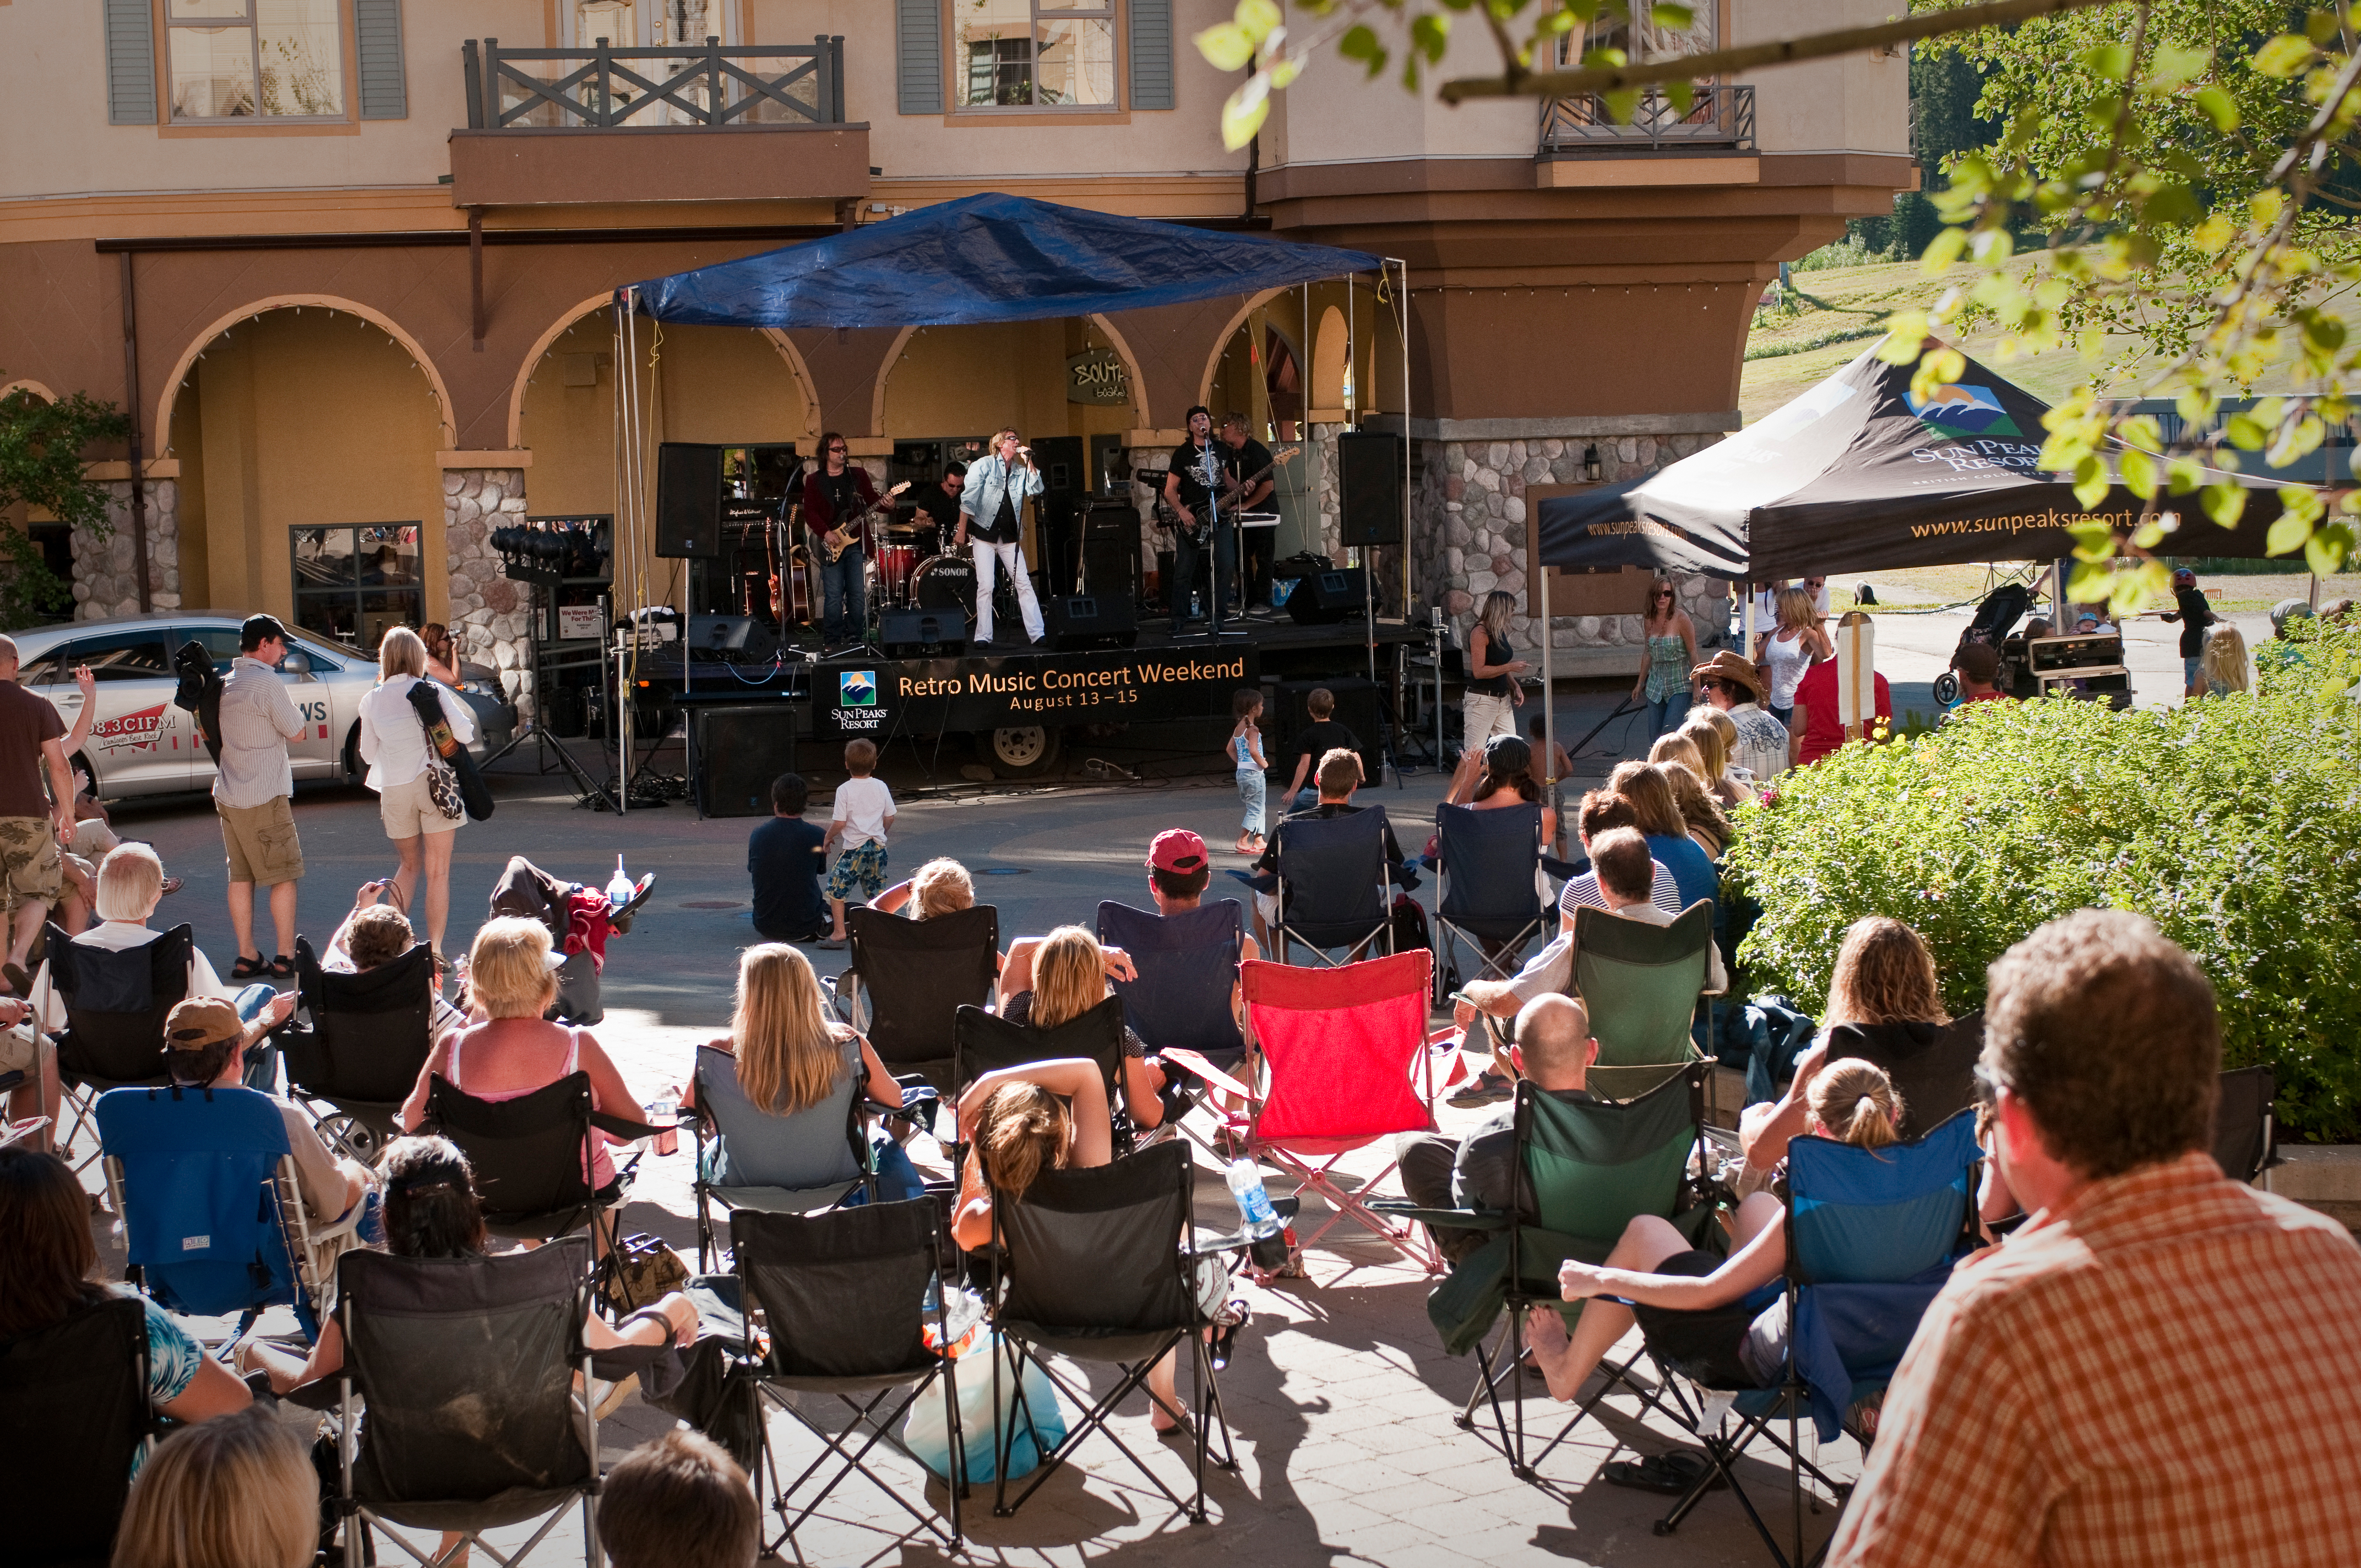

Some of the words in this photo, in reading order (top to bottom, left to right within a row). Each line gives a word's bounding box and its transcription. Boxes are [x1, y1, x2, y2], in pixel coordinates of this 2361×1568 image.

[1911, 444, 1979, 464] SUN
[1974, 439, 2048, 455] PEAK
[1912, 476, 1968, 485] BRITISH
[1973, 471, 2046, 480] COLUMBIA
[1587, 515, 1688, 540] www.sunpeaksresort.com
[1911, 508, 2181, 538] www.sunpeaksresort.co
[938, 568, 969, 576] SONOR
[899, 677, 962, 696] Retro
[969, 671, 1036, 694] Music
[1042, 667, 1131, 689] Concert
[1137, 657, 1244, 683] Weekend
[1009, 694, 1073, 711] August
[831, 709, 855, 720] SUN
[855, 708, 887, 718] PEAKS
[123, 715, 176, 732] CIFM
[840, 718, 879, 729] RESORT
[186, 1237, 208, 1245] RIO
